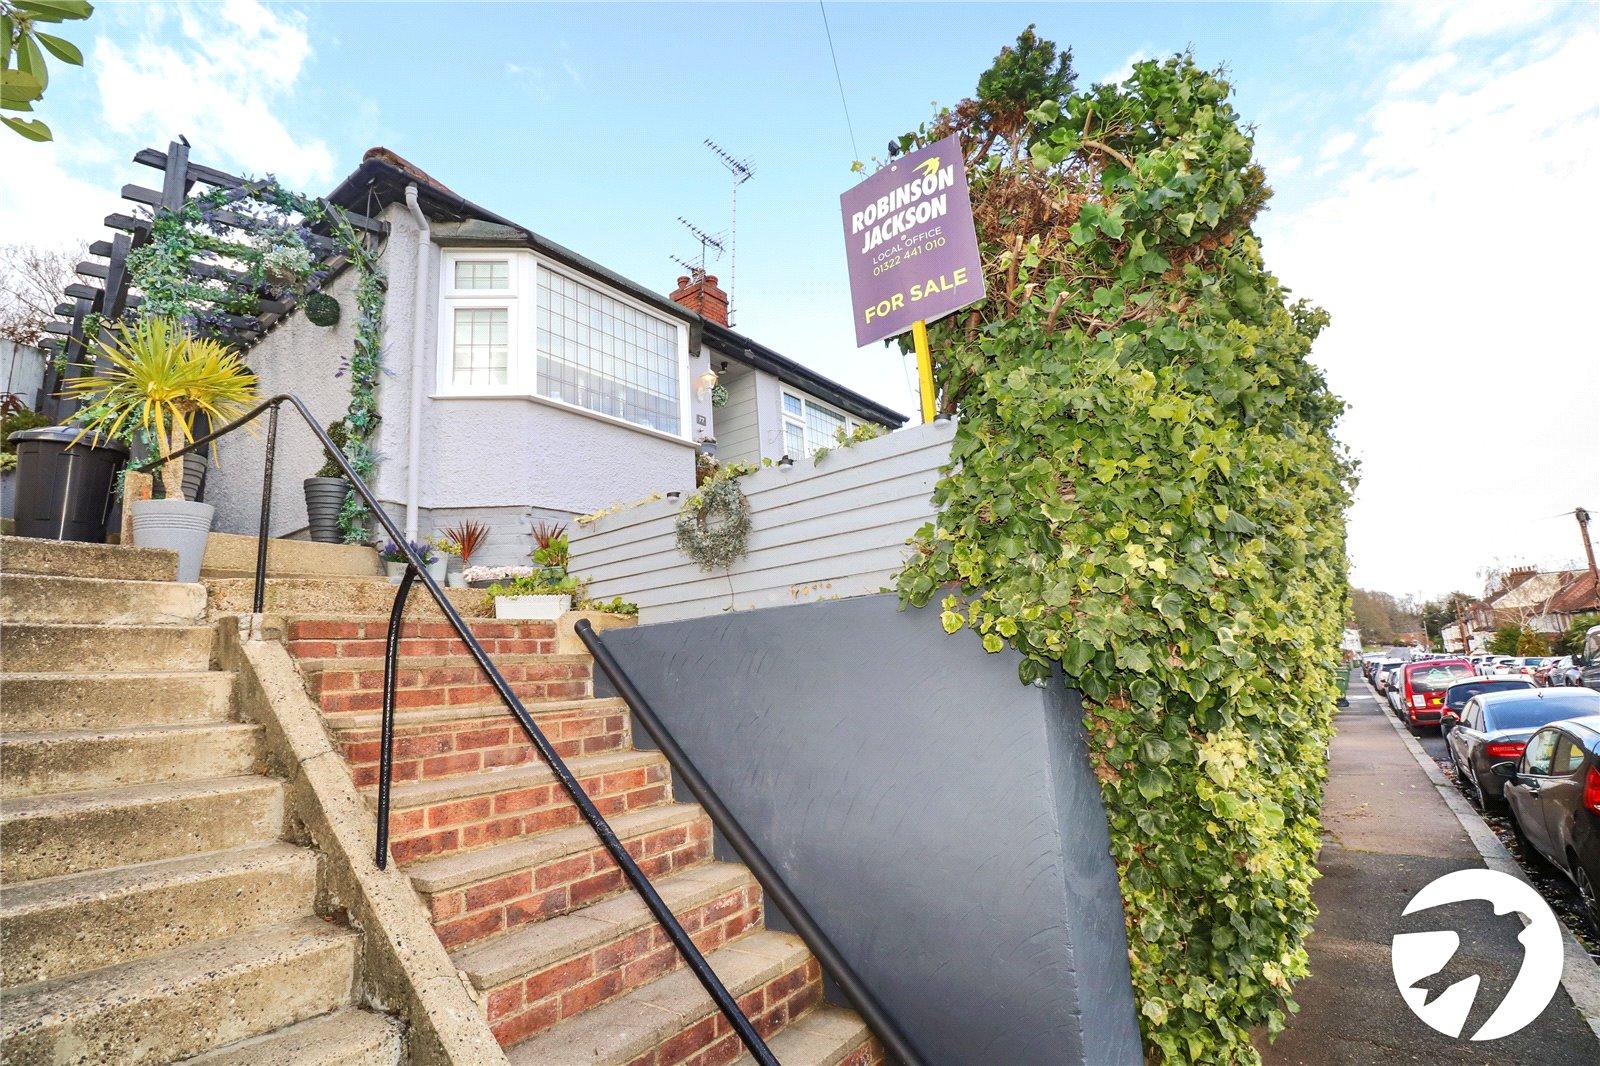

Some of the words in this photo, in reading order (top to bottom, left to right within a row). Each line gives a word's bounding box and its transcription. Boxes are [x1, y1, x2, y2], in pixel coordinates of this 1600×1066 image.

[852, 164, 954, 234] ROBINSON
[861, 194, 947, 254] JACKSON
[873, 244, 902, 265] LOCAL
[905, 227, 942, 247] OFFICE
[873, 257, 901, 276] 01322
[904, 245, 922, 260] 441
[926, 237, 946, 252] 010
[865, 294, 905, 324] FOR
[910, 268, 968, 302] SALE
